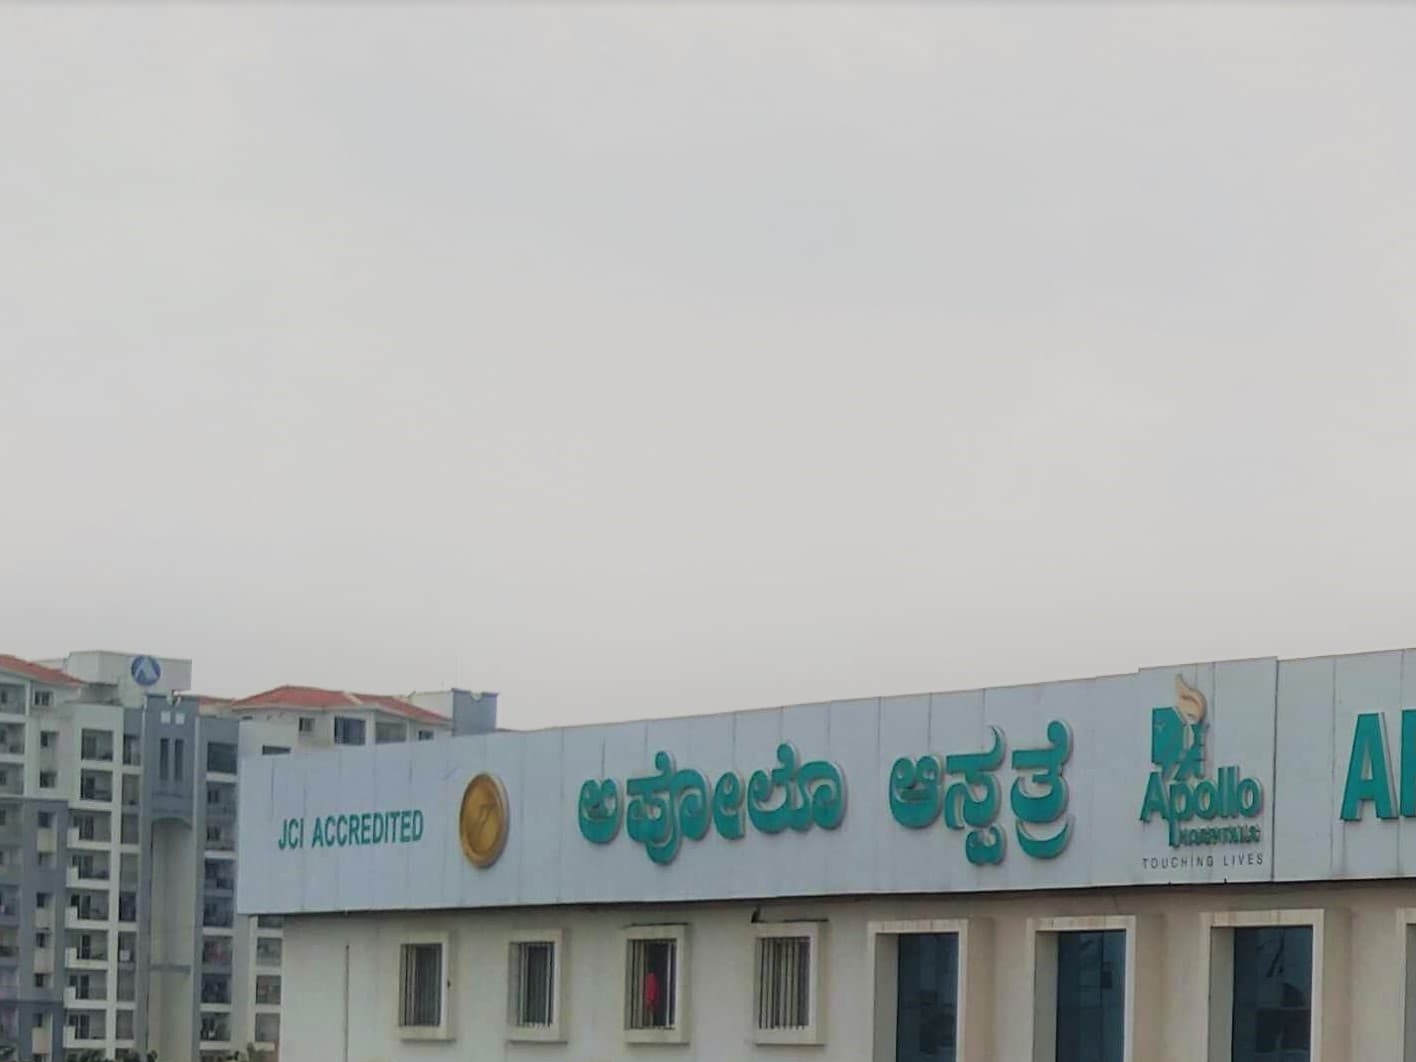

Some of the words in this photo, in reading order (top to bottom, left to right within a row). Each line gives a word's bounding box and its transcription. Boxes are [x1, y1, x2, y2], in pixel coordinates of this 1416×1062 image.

[1139, 765, 1264, 848] Apollo
[278, 818, 304, 850] JCI
[311, 810, 424, 848] ACCREDITED
[1142, 855, 1214, 869] TOUCHING
[1223, 853, 1264, 866] LIVES
